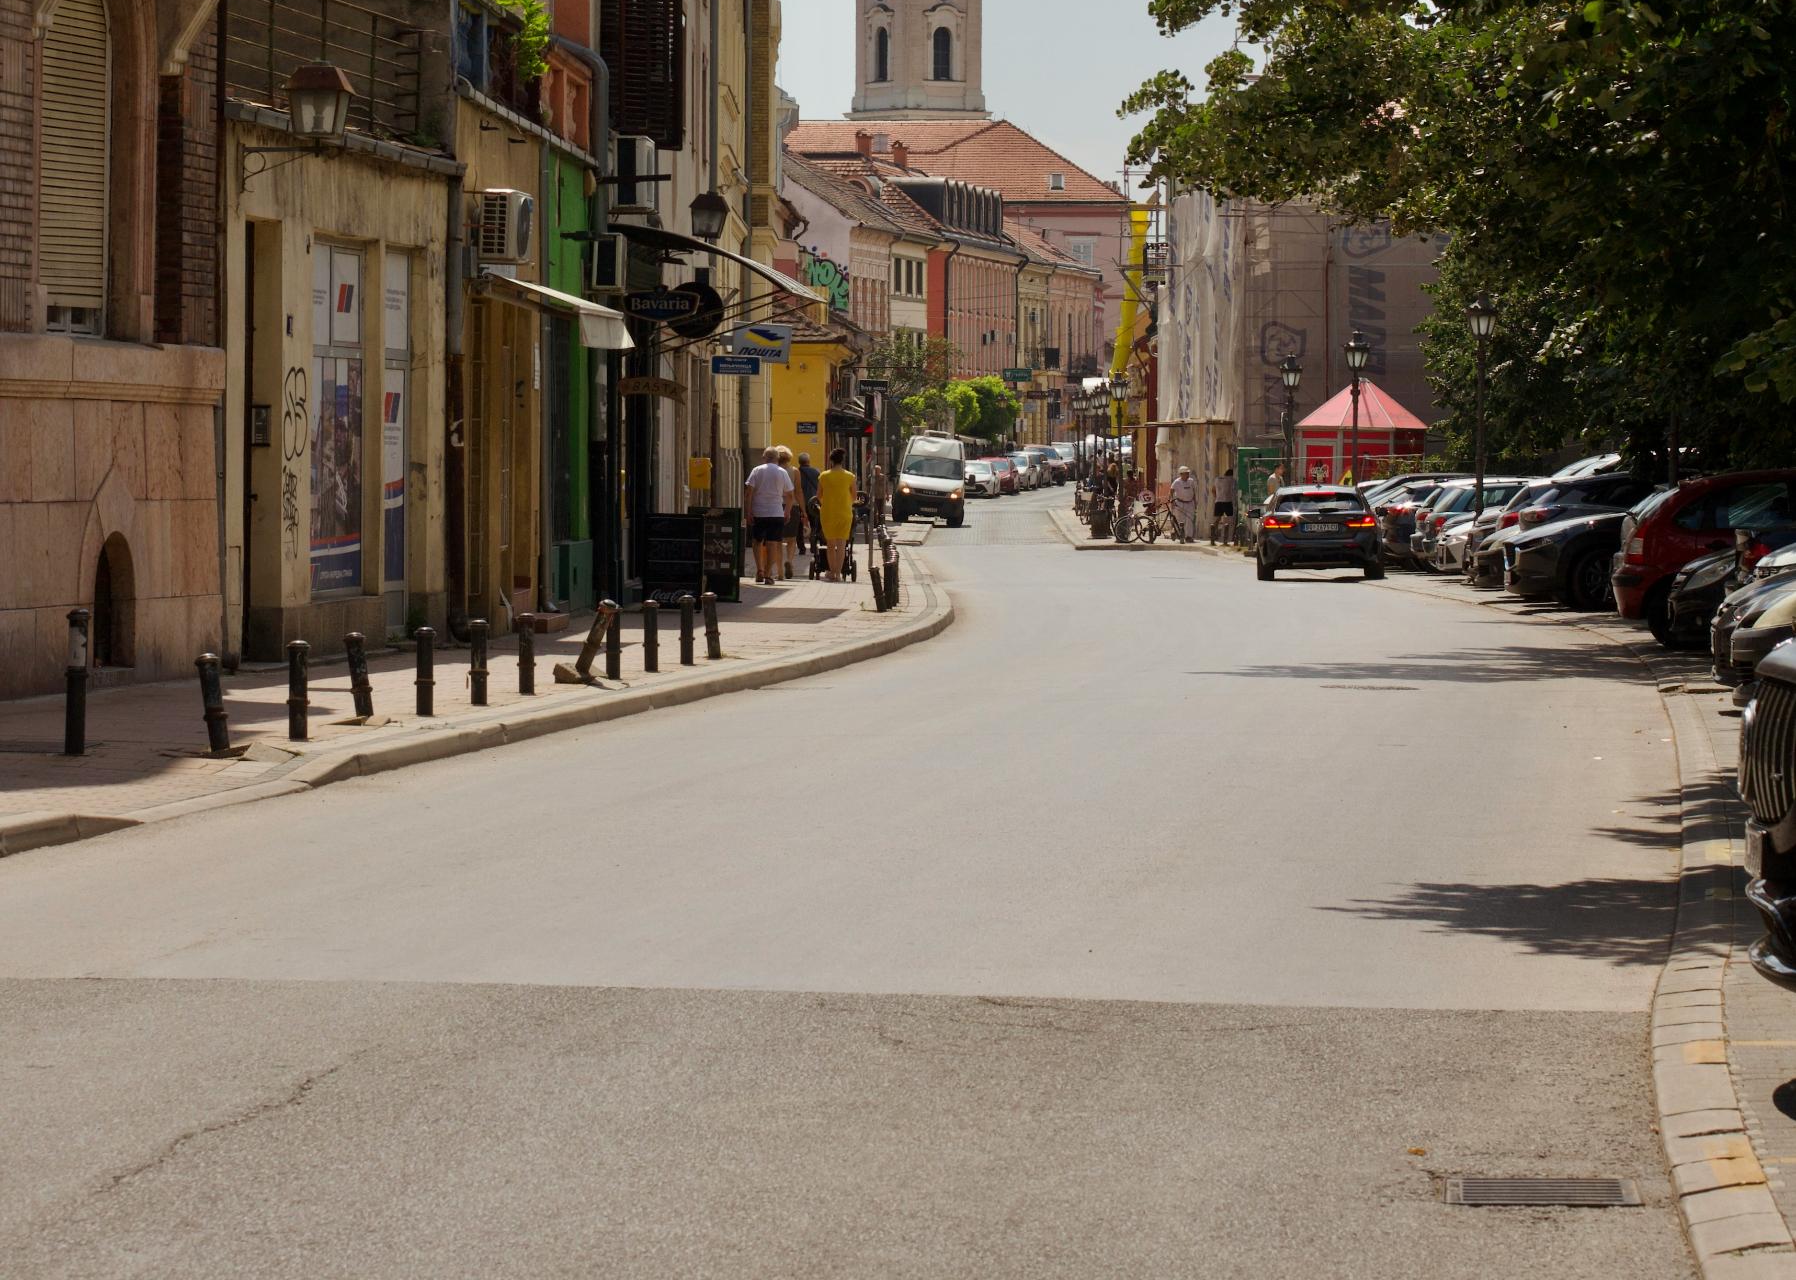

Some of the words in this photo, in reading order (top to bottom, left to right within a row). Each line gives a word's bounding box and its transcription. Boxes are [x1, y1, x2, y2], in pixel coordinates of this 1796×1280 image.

[631, 297, 689, 311] Bavaria
[738, 347, 782, 358] ПОШТА
[632, 381, 678, 395] BASTA
